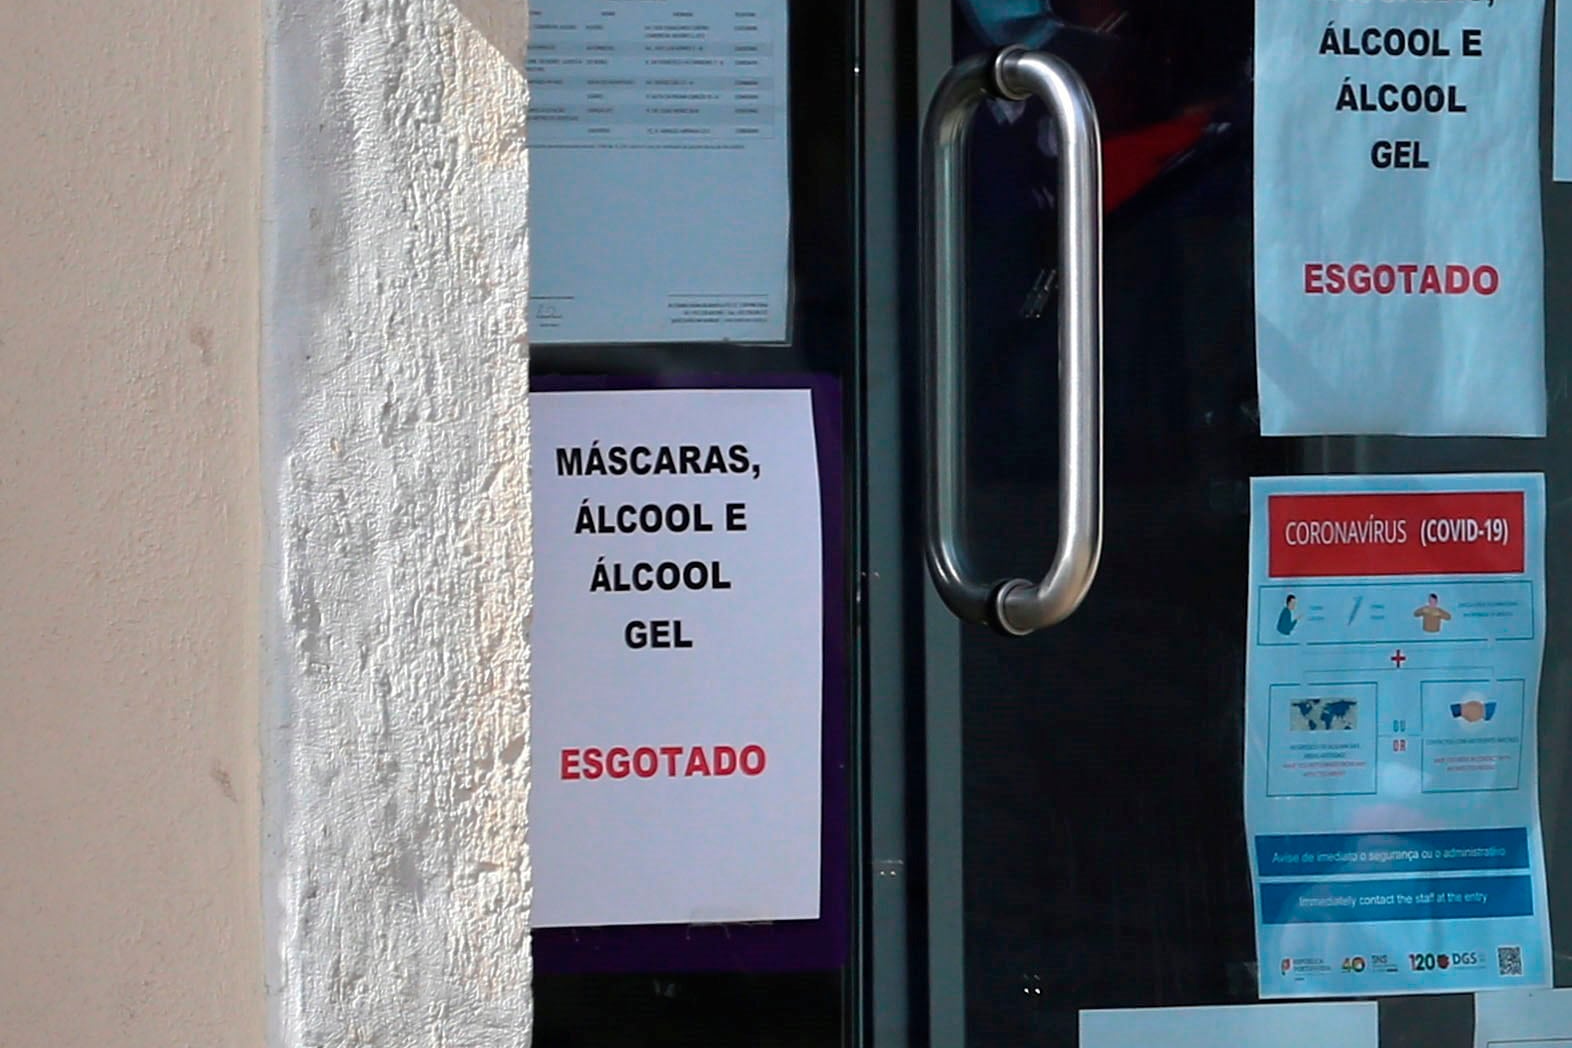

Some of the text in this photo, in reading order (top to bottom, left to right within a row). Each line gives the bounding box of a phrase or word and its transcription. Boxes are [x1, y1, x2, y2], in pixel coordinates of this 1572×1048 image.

[1320, 21, 1482, 56] ÁLCOOL E
[1336, 77, 1466, 112] ÁLCOOL
[1371, 141, 1429, 168] GEL
[1303, 262, 1498, 296] ESGOTADO
[556, 440, 760, 479] MÁSCARAS,
[575, 499, 746, 534] ÁLCOOL E
[1286, 514, 1508, 546] CORONAVÍRUS (COVID-19)
[590, 557, 731, 592] ÁLCOOL
[625, 621, 692, 649] GEL
[561, 744, 767, 780] ESGOTADO
[1302, 853, 1314, 862] de
[1369, 849, 1419, 862] segurança
[1421, 850, 1432, 859] ou
[1435, 850, 1441, 858] o
[1299, 896, 1357, 908] Immediately
[1360, 895, 1394, 905] contact
[1397, 895, 1412, 904] the
[1437, 893, 1445, 902] at
[1447, 893, 1461, 902] the
[1464, 892, 1487, 904] entry
[1409, 953, 1436, 970] 120
[1453, 952, 1477, 965] DGS
